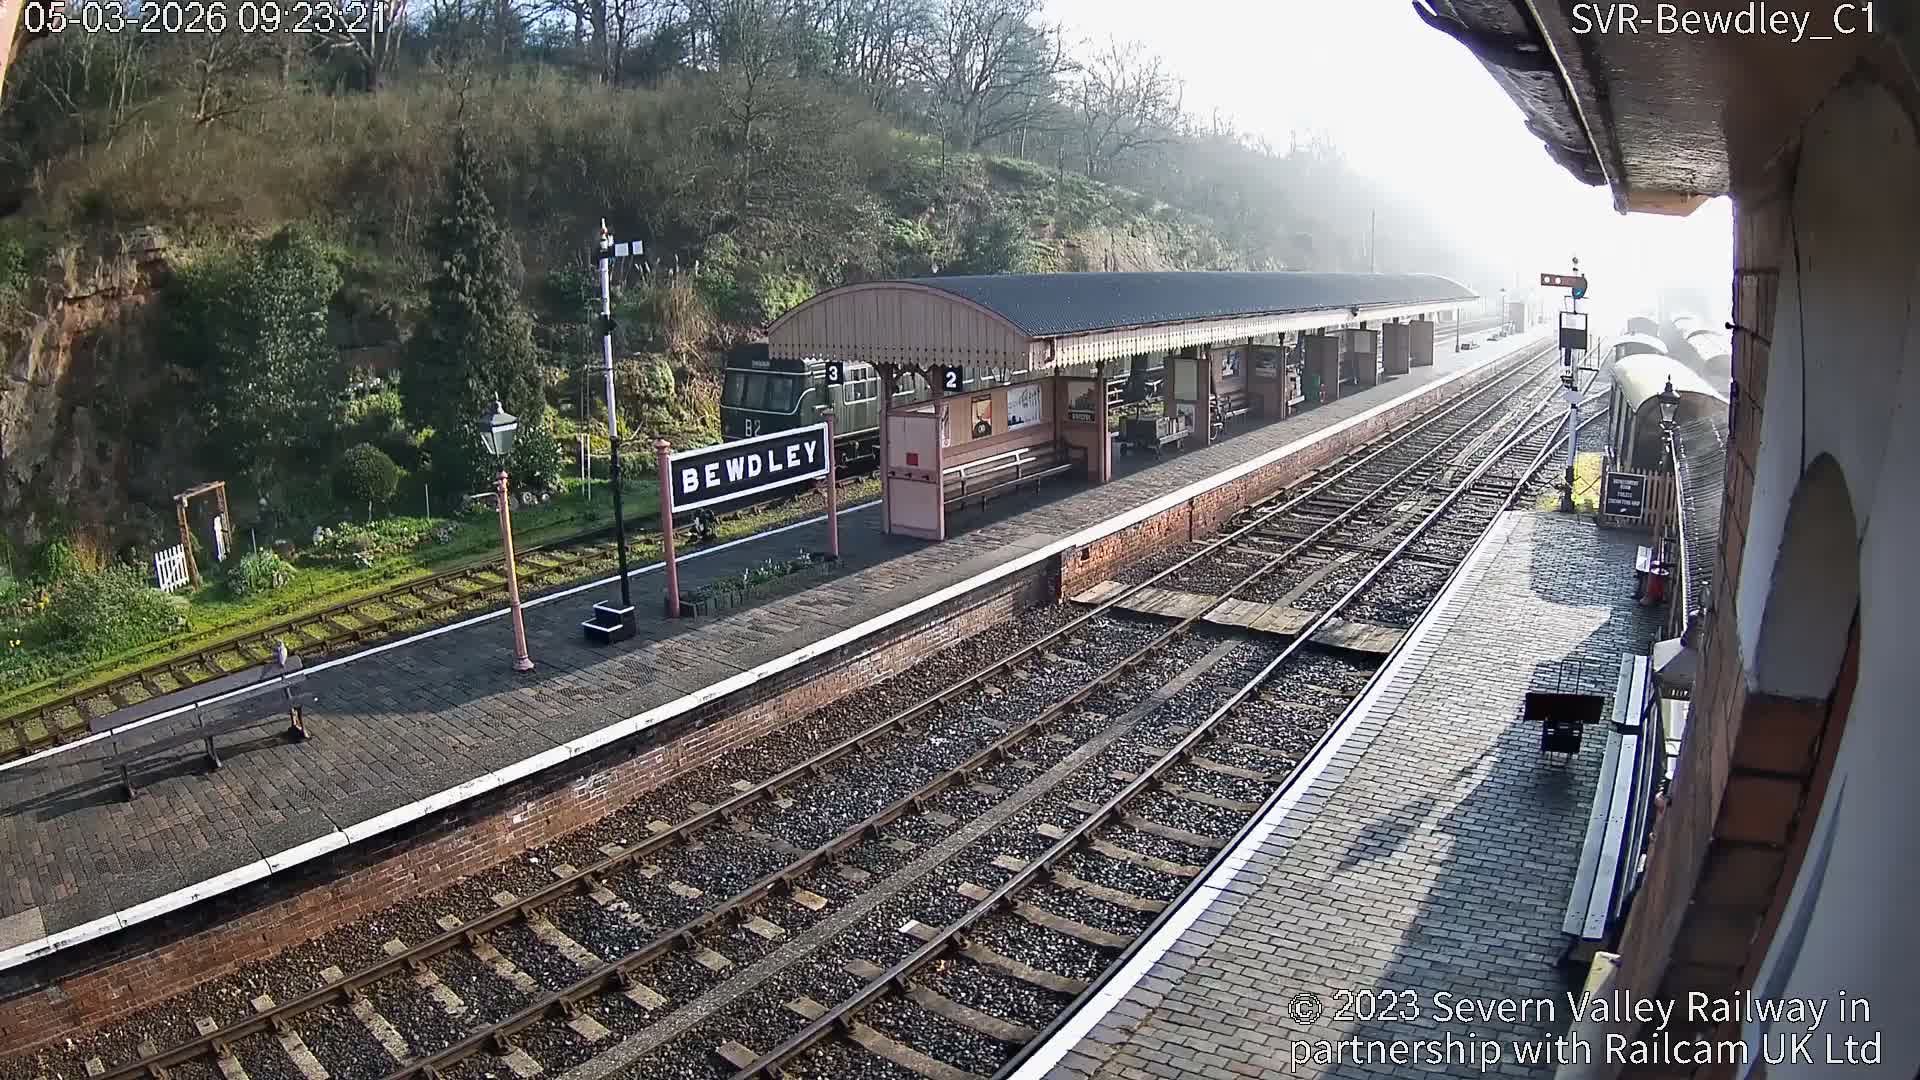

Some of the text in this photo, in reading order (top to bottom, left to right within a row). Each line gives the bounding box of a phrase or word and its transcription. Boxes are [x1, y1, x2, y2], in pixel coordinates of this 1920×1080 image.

[828, 365, 839, 381] 3
[945, 371, 957, 388] 2
[682, 440, 817, 495] BEWDLEY
